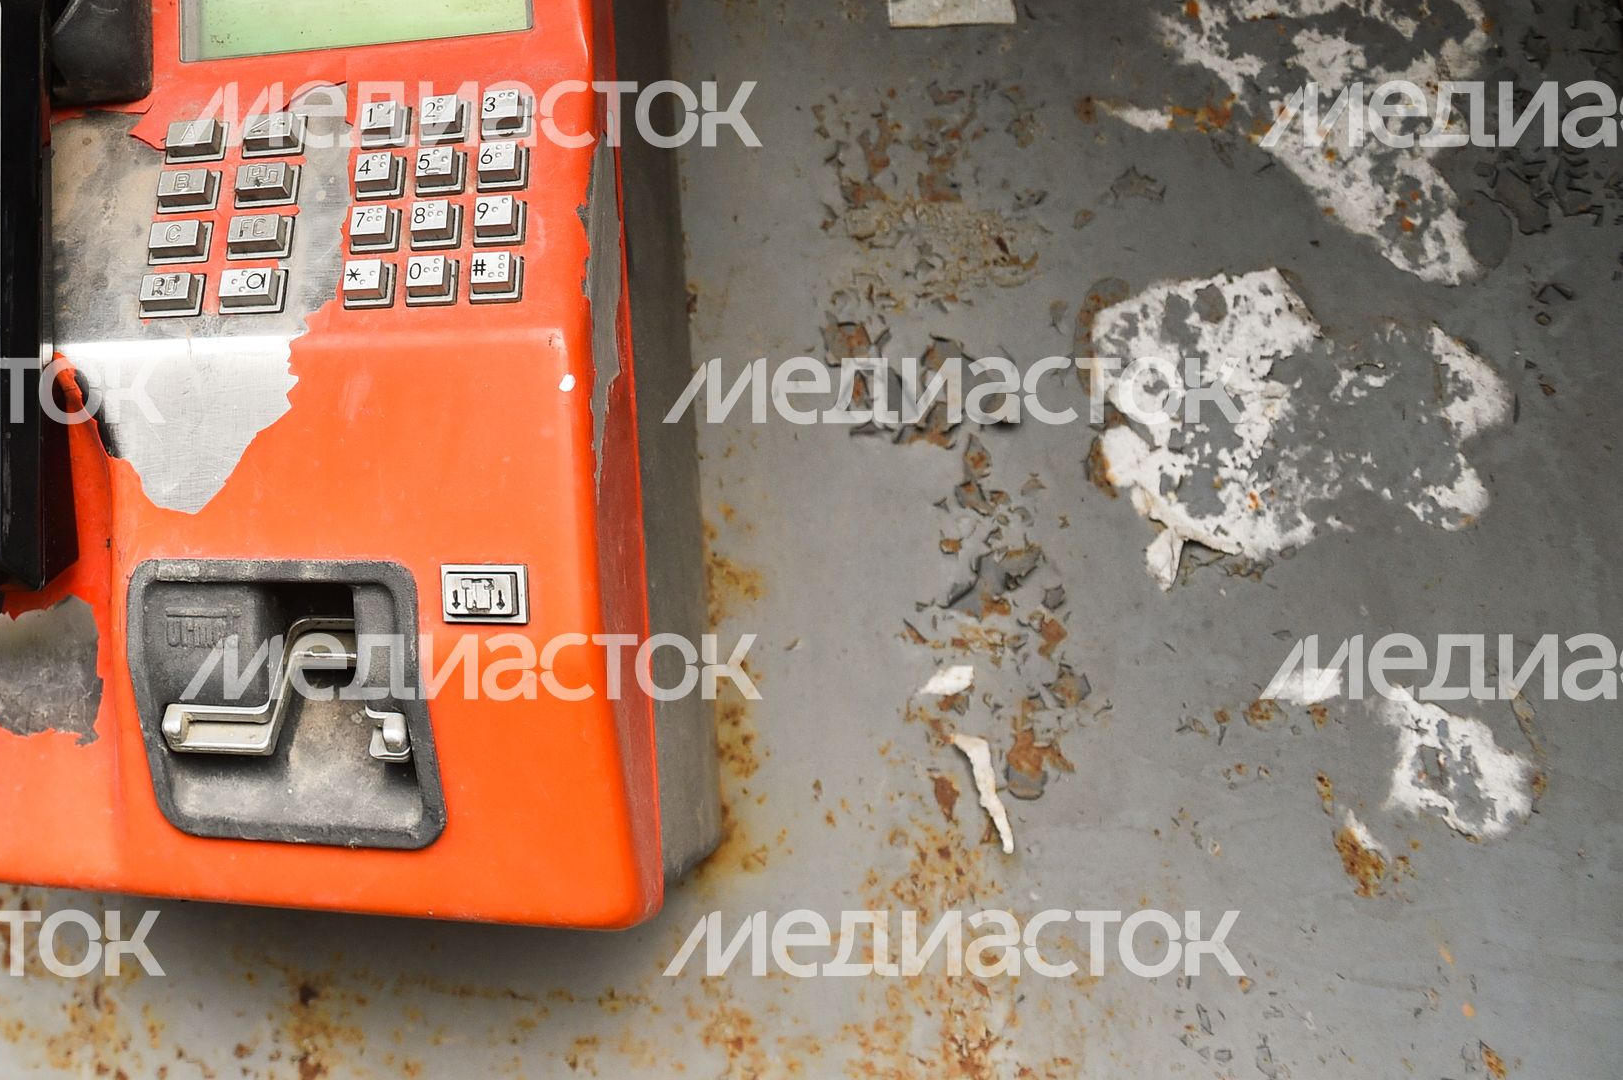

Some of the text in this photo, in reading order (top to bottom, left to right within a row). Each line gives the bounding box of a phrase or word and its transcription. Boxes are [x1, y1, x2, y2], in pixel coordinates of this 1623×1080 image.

[424, 101, 437, 118] 2
[483, 96, 496, 113] 3
[366, 107, 374, 123] 1
[417, 153, 431, 170] 5
[480, 147, 493, 165] 6
[357, 159, 372, 175] 4
[173, 172, 189, 191] B
[356, 211, 366, 228] 7
[413, 207, 426, 224] 8
[476, 202, 489, 220] 9
[165, 223, 182, 243] C
[239, 218, 267, 238] FC
[409, 262, 422, 280] 0
[472, 258, 487, 277] #
[151, 275, 179, 297] RD
